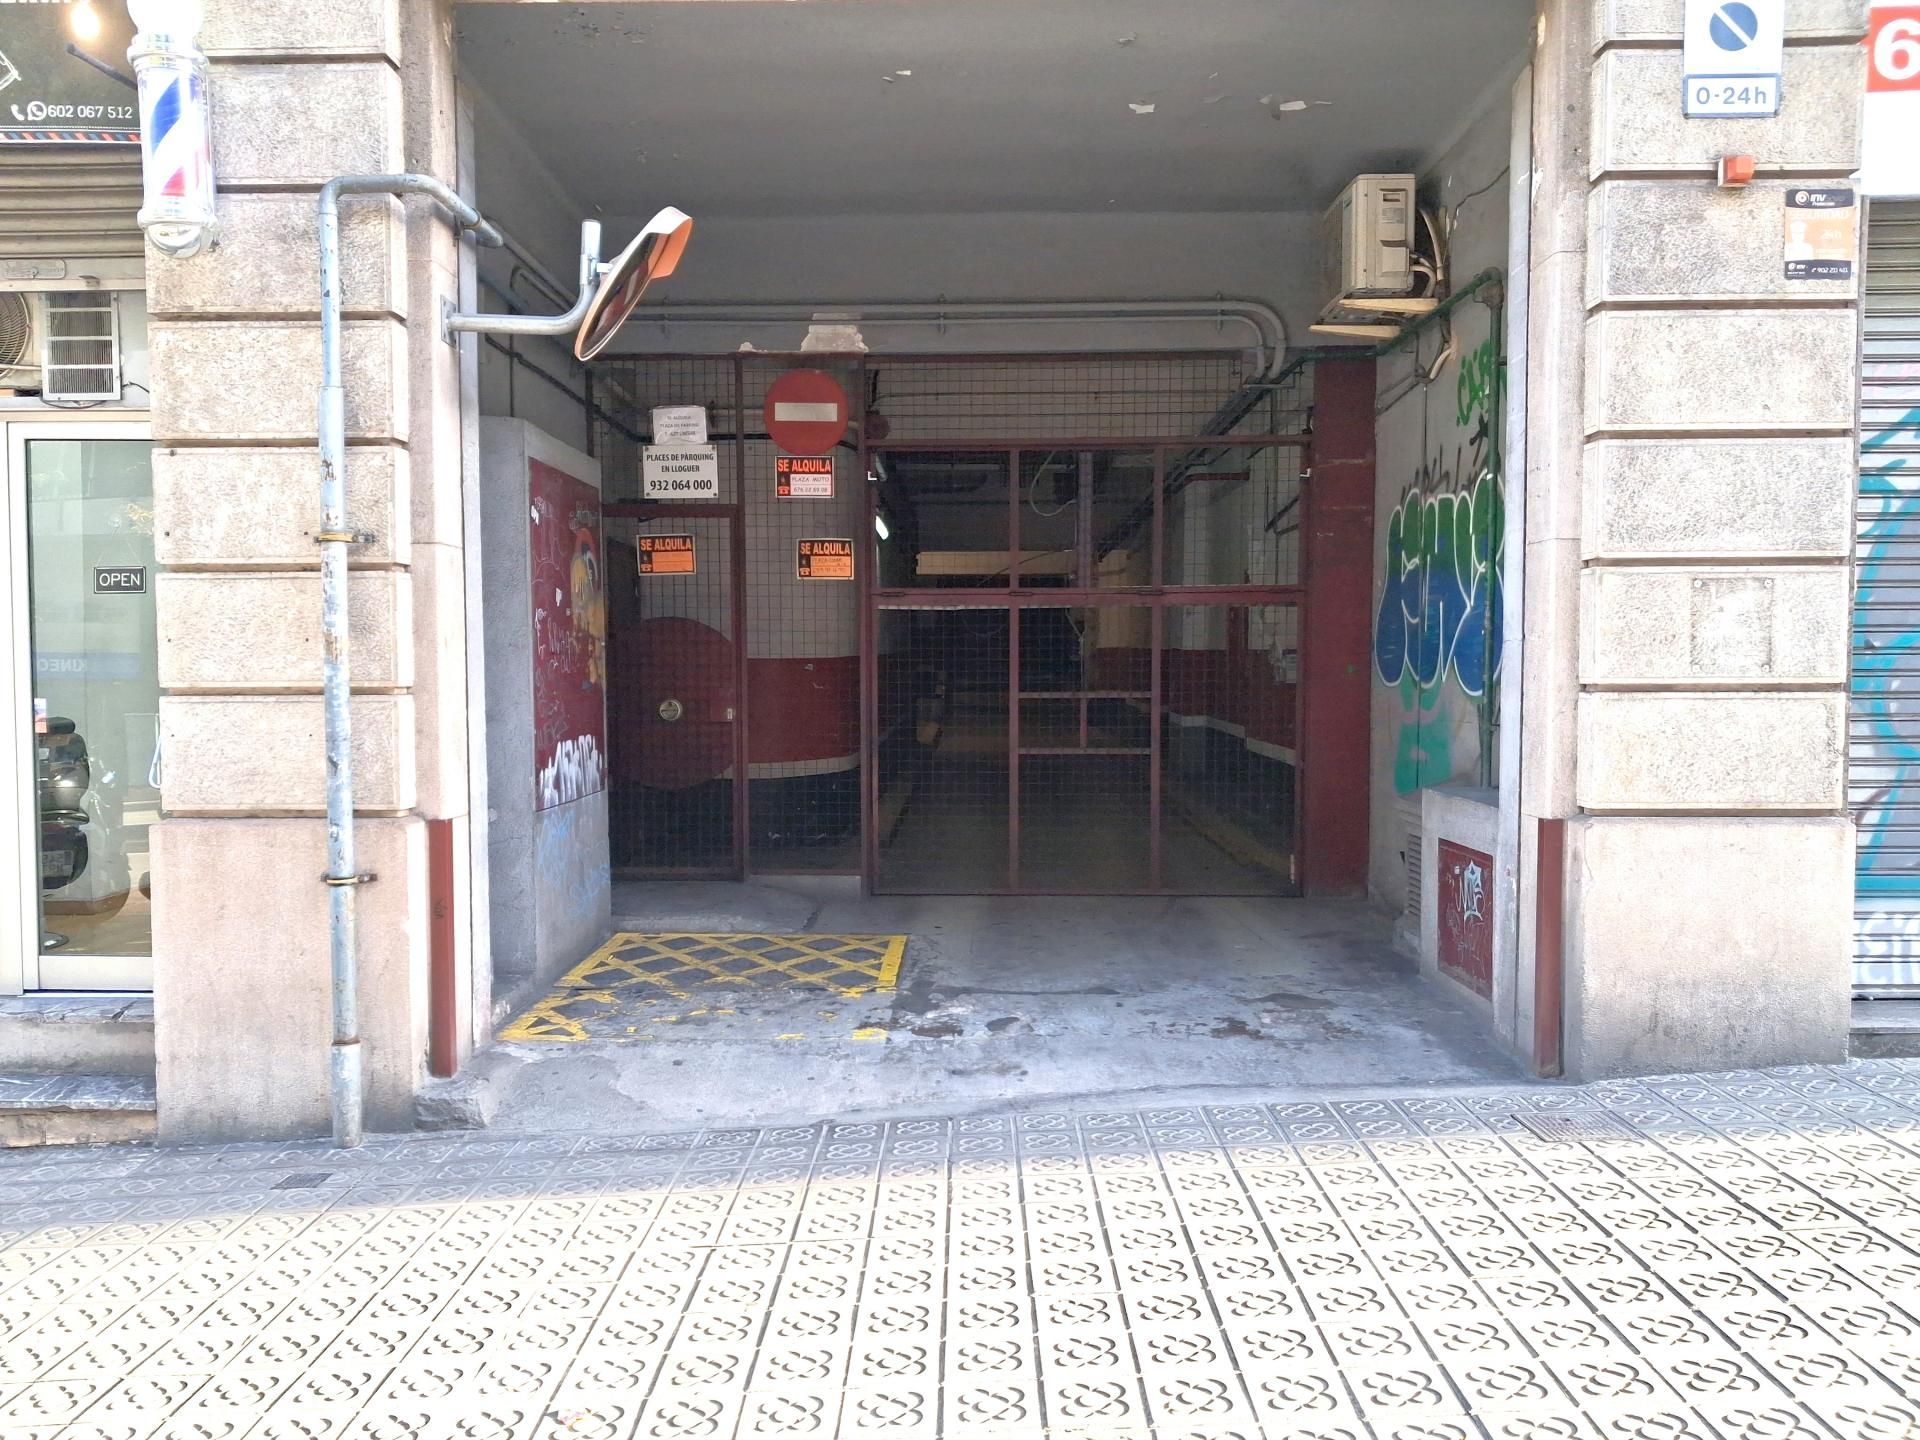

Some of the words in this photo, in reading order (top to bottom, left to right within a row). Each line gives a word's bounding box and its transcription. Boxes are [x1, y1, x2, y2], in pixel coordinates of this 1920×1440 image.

[1696, 87, 1767, 105] 0-24h
[48, 104, 74, 118] 602
[77, 105, 104, 118] 067
[107, 106, 133, 119] 512
[646, 454, 670, 462] PLACES
[671, 453, 680, 461] DE
[681, 452, 714, 462] PÀRQUING
[661, 465, 670, 473] EN
[671, 464, 700, 473] LLOGUER
[777, 459, 790, 472] SE
[791, 459, 831, 473] ALQUILA
[650, 480, 669, 491] 932
[671, 479, 691, 491] 064
[693, 479, 712, 491] 000
[640, 539, 652, 551] SE
[654, 538, 692, 551] ALQUILA
[800, 542, 811, 555] SE
[812, 542, 850, 555] ALQUILA
[99, 573, 140, 586] OPEN
